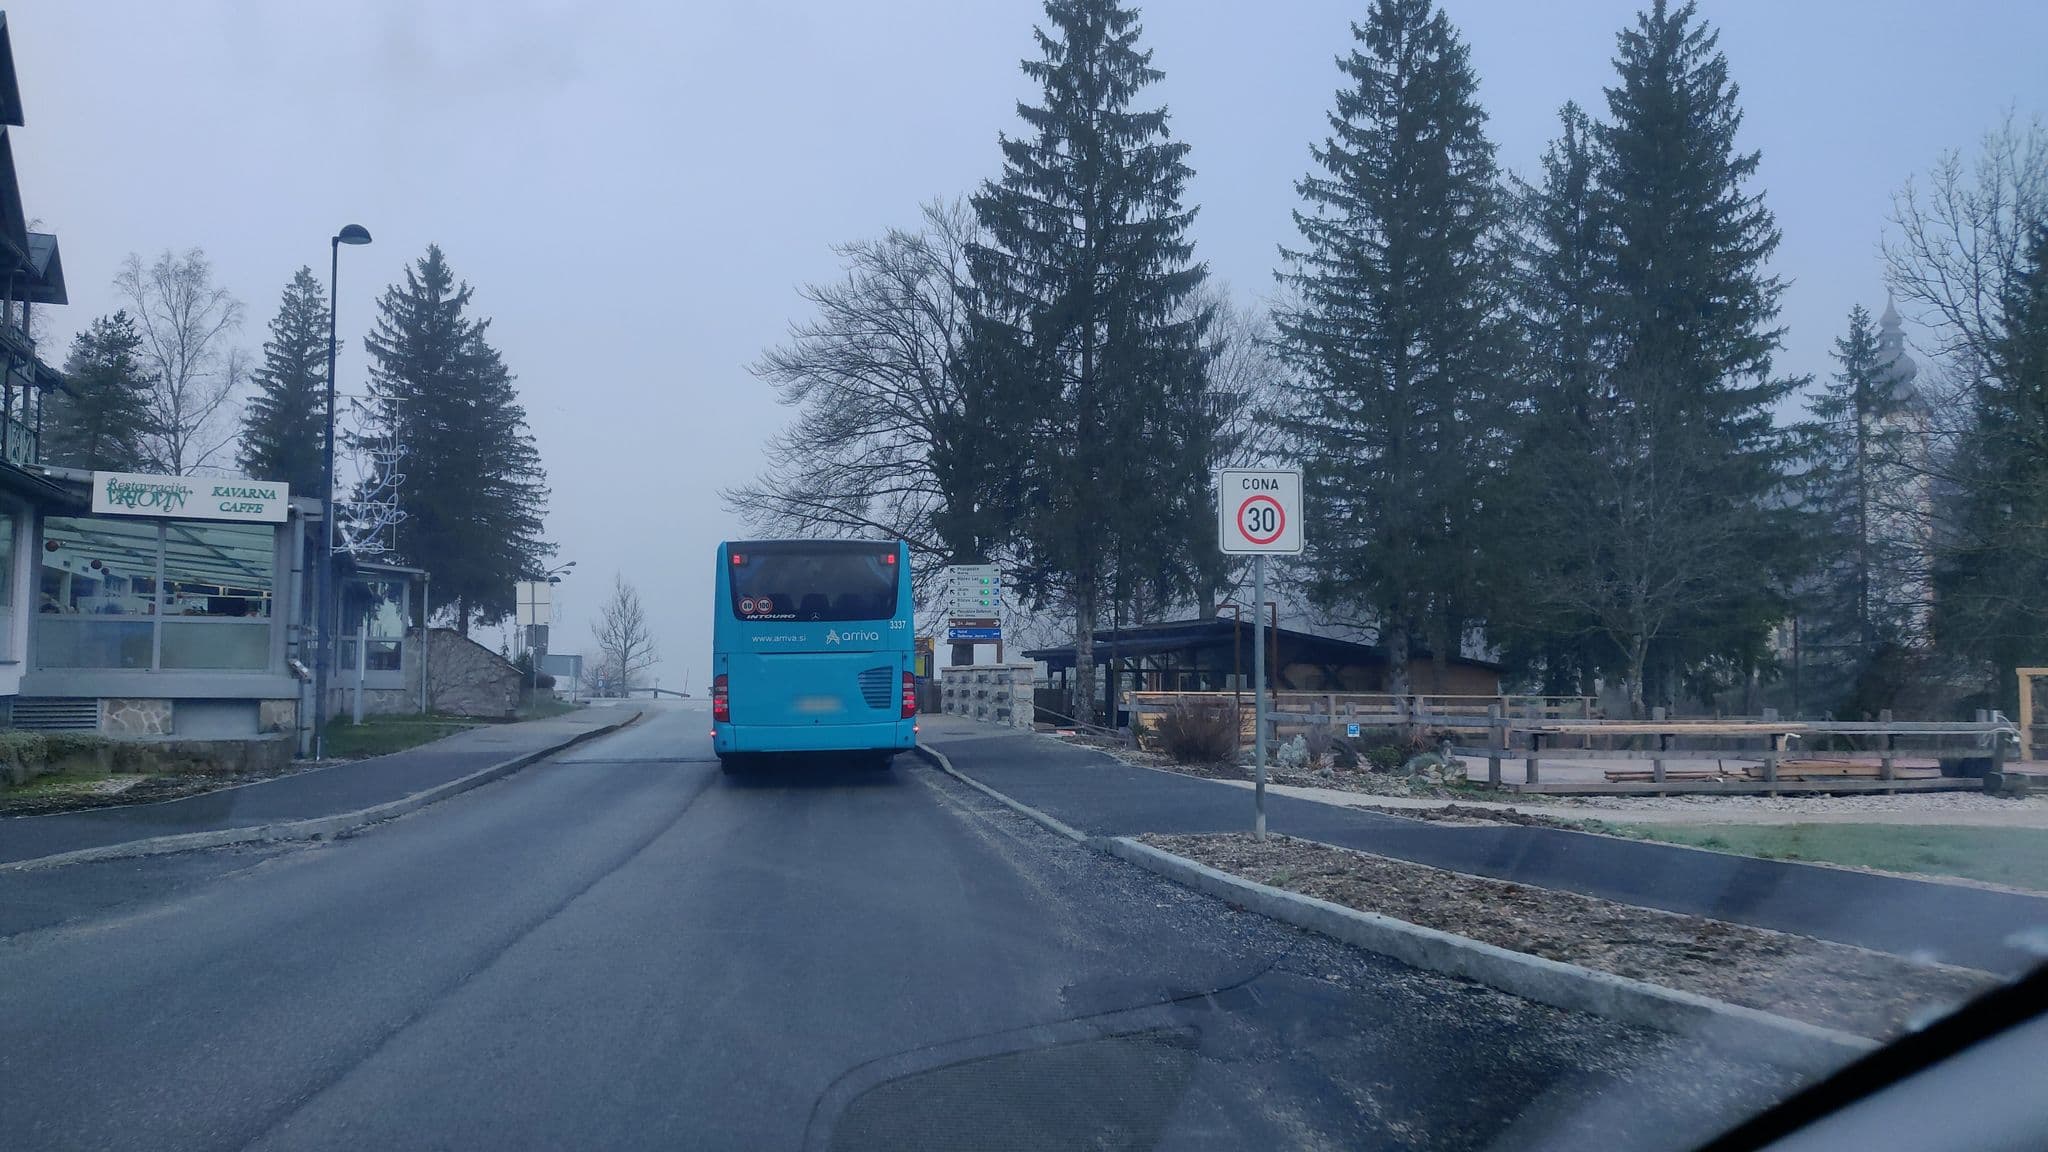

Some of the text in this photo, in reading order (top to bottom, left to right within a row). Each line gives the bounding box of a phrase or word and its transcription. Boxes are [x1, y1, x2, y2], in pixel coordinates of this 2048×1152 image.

[1242, 478, 1279, 490] CONA
[211, 486, 277, 500] KAVARNA
[219, 501, 264, 514] CAFFE
[1247, 507, 1275, 532] 30
[889, 620, 907, 630] 3337
[752, 634, 807, 643] www.arriva.si
[841, 630, 879, 641] arriva
